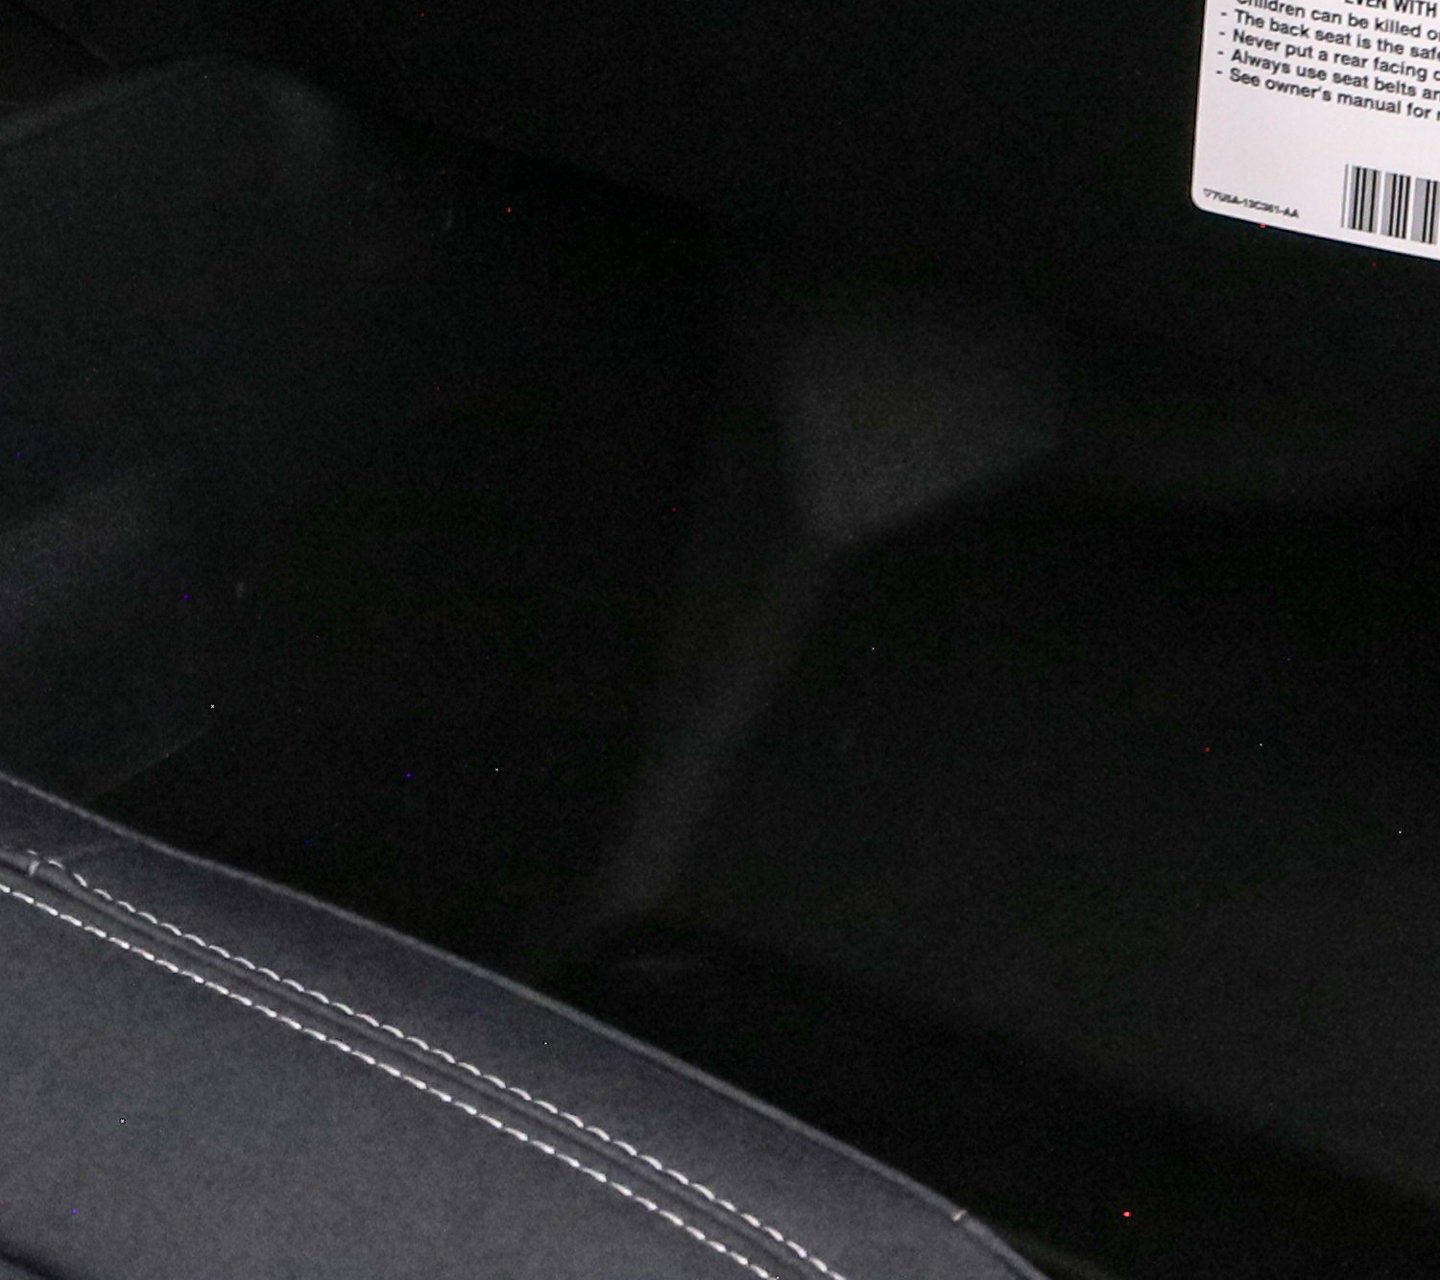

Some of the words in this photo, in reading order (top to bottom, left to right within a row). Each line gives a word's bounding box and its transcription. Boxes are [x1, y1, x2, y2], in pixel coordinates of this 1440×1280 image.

[1234, 8, 1266, 30] The
[1269, 17, 1311, 40] back
[1315, 29, 1353, 47] seat
[1356, 33, 1372, 51] is
[1376, 38, 1405, 56] the
[1310, 9, 1343, 26] can
[1347, 12, 1370, 30] be
[1374, 17, 1422, 39] killed
[1231, 48, 1292, 76] Always
[1296, 65, 1328, 82] use
[1332, 72, 1370, 90] seat
[1374, 76, 1417, 98] belts
[1233, 28, 1282, 53] Never
[1285, 42, 1314, 65] put
[1318, 50, 1329, 63] a
[1333, 52, 1370, 69] rear
[1373, 56, 1429, 84] facing
[1229, 67, 1261, 88] See
[1264, 78, 1333, 103] owner's
[1337, 92, 1402, 115] manual
[1406, 102, 1433, 120] for
